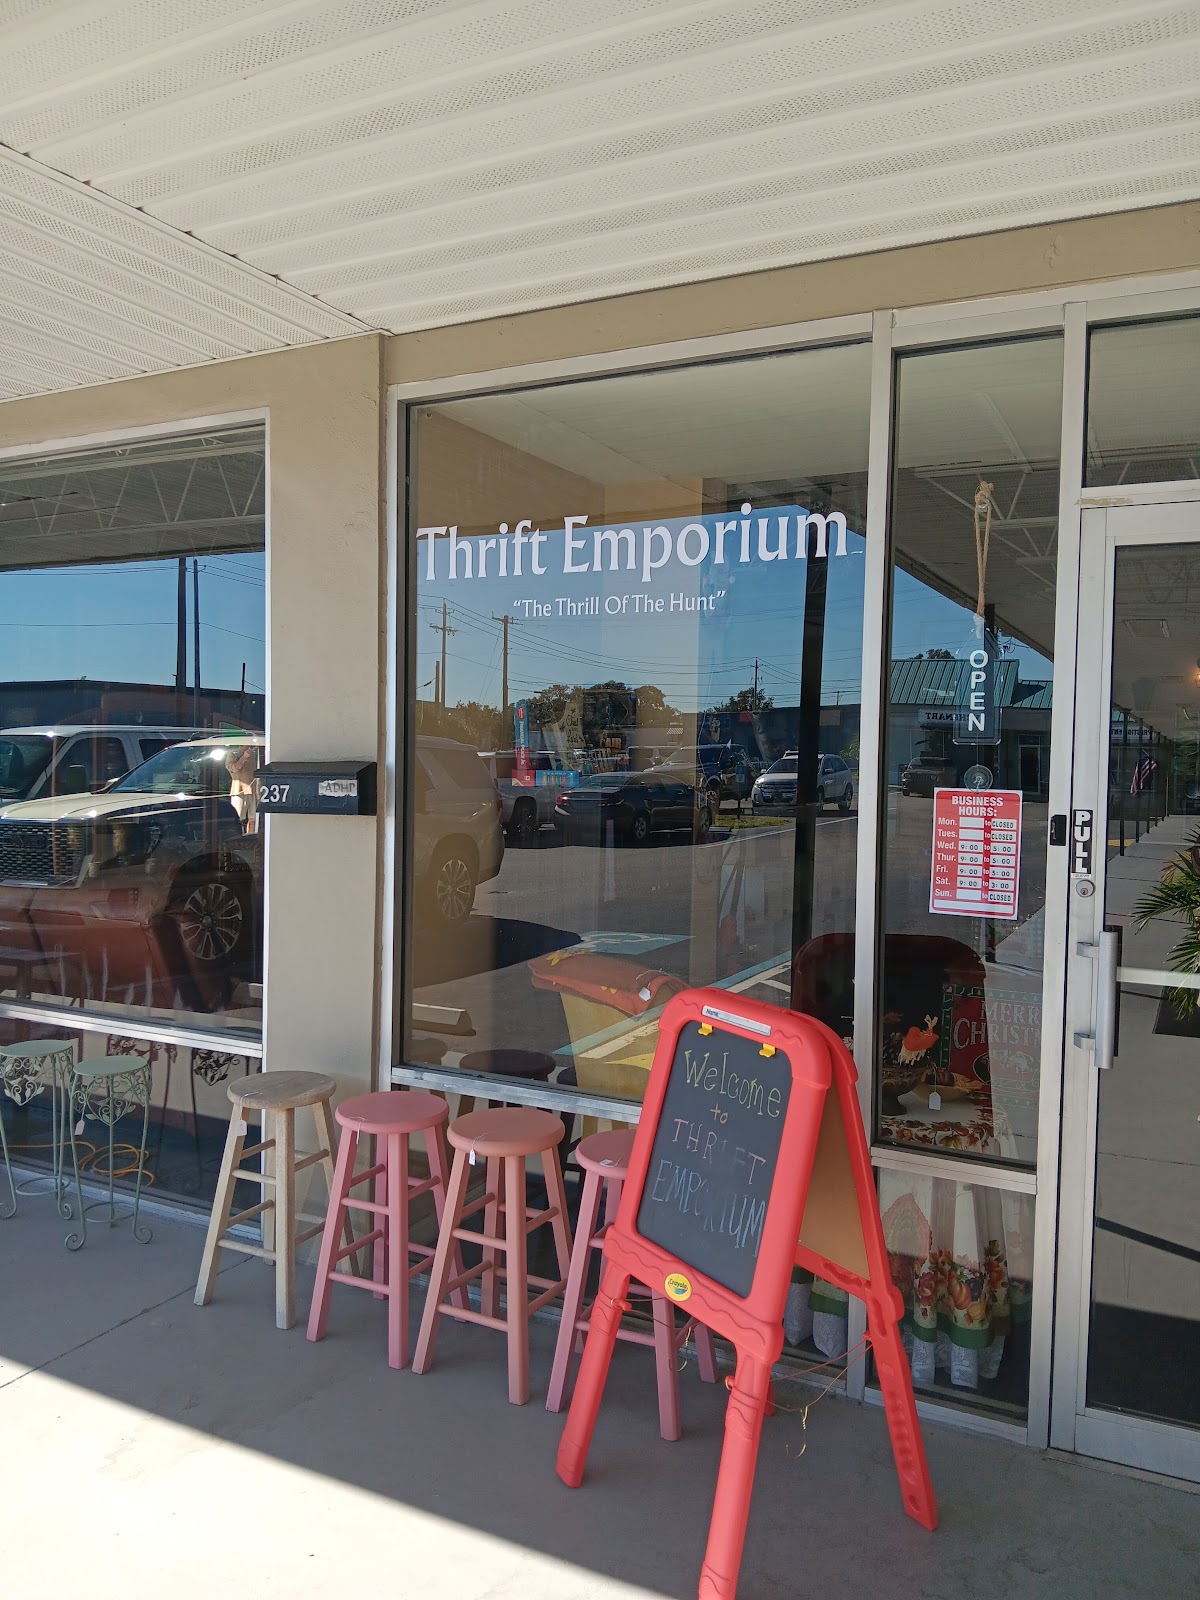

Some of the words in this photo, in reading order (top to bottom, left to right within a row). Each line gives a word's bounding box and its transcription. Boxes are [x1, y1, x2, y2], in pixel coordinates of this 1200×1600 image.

[416, 519, 547, 581] Thrift
[563, 502, 848, 582] Emporium
[555, 596, 599, 616] Thrill
[605, 594, 629, 615] Of
[631, 593, 665, 614] The
[968, 650, 989, 732] OPEN
[260, 785, 290, 804] 237
[952, 796, 1004, 807] BUSINESS
[958, 806, 997, 817] HOURS:
[938, 817, 957, 826] Mon.
[985, 819, 991, 827] to
[991, 820, 1014, 829] CLOSED
[938, 829, 958, 838] Tues.
[991, 832, 1014, 841] CLOSED
[937, 841, 956, 850] Wed.
[1074, 811, 1091, 873] PULL
[937, 853, 956, 862] Thur.
[936, 865, 948, 873] Fri.
[935, 877, 951, 886] Sat.
[935, 889, 952, 898] Sun.
[989, 893, 1012, 902] CLOSED
[684, 1049, 782, 1118] Welcome
[710, 1103, 729, 1124] to
[669, 1278, 689, 1290] Crayola
